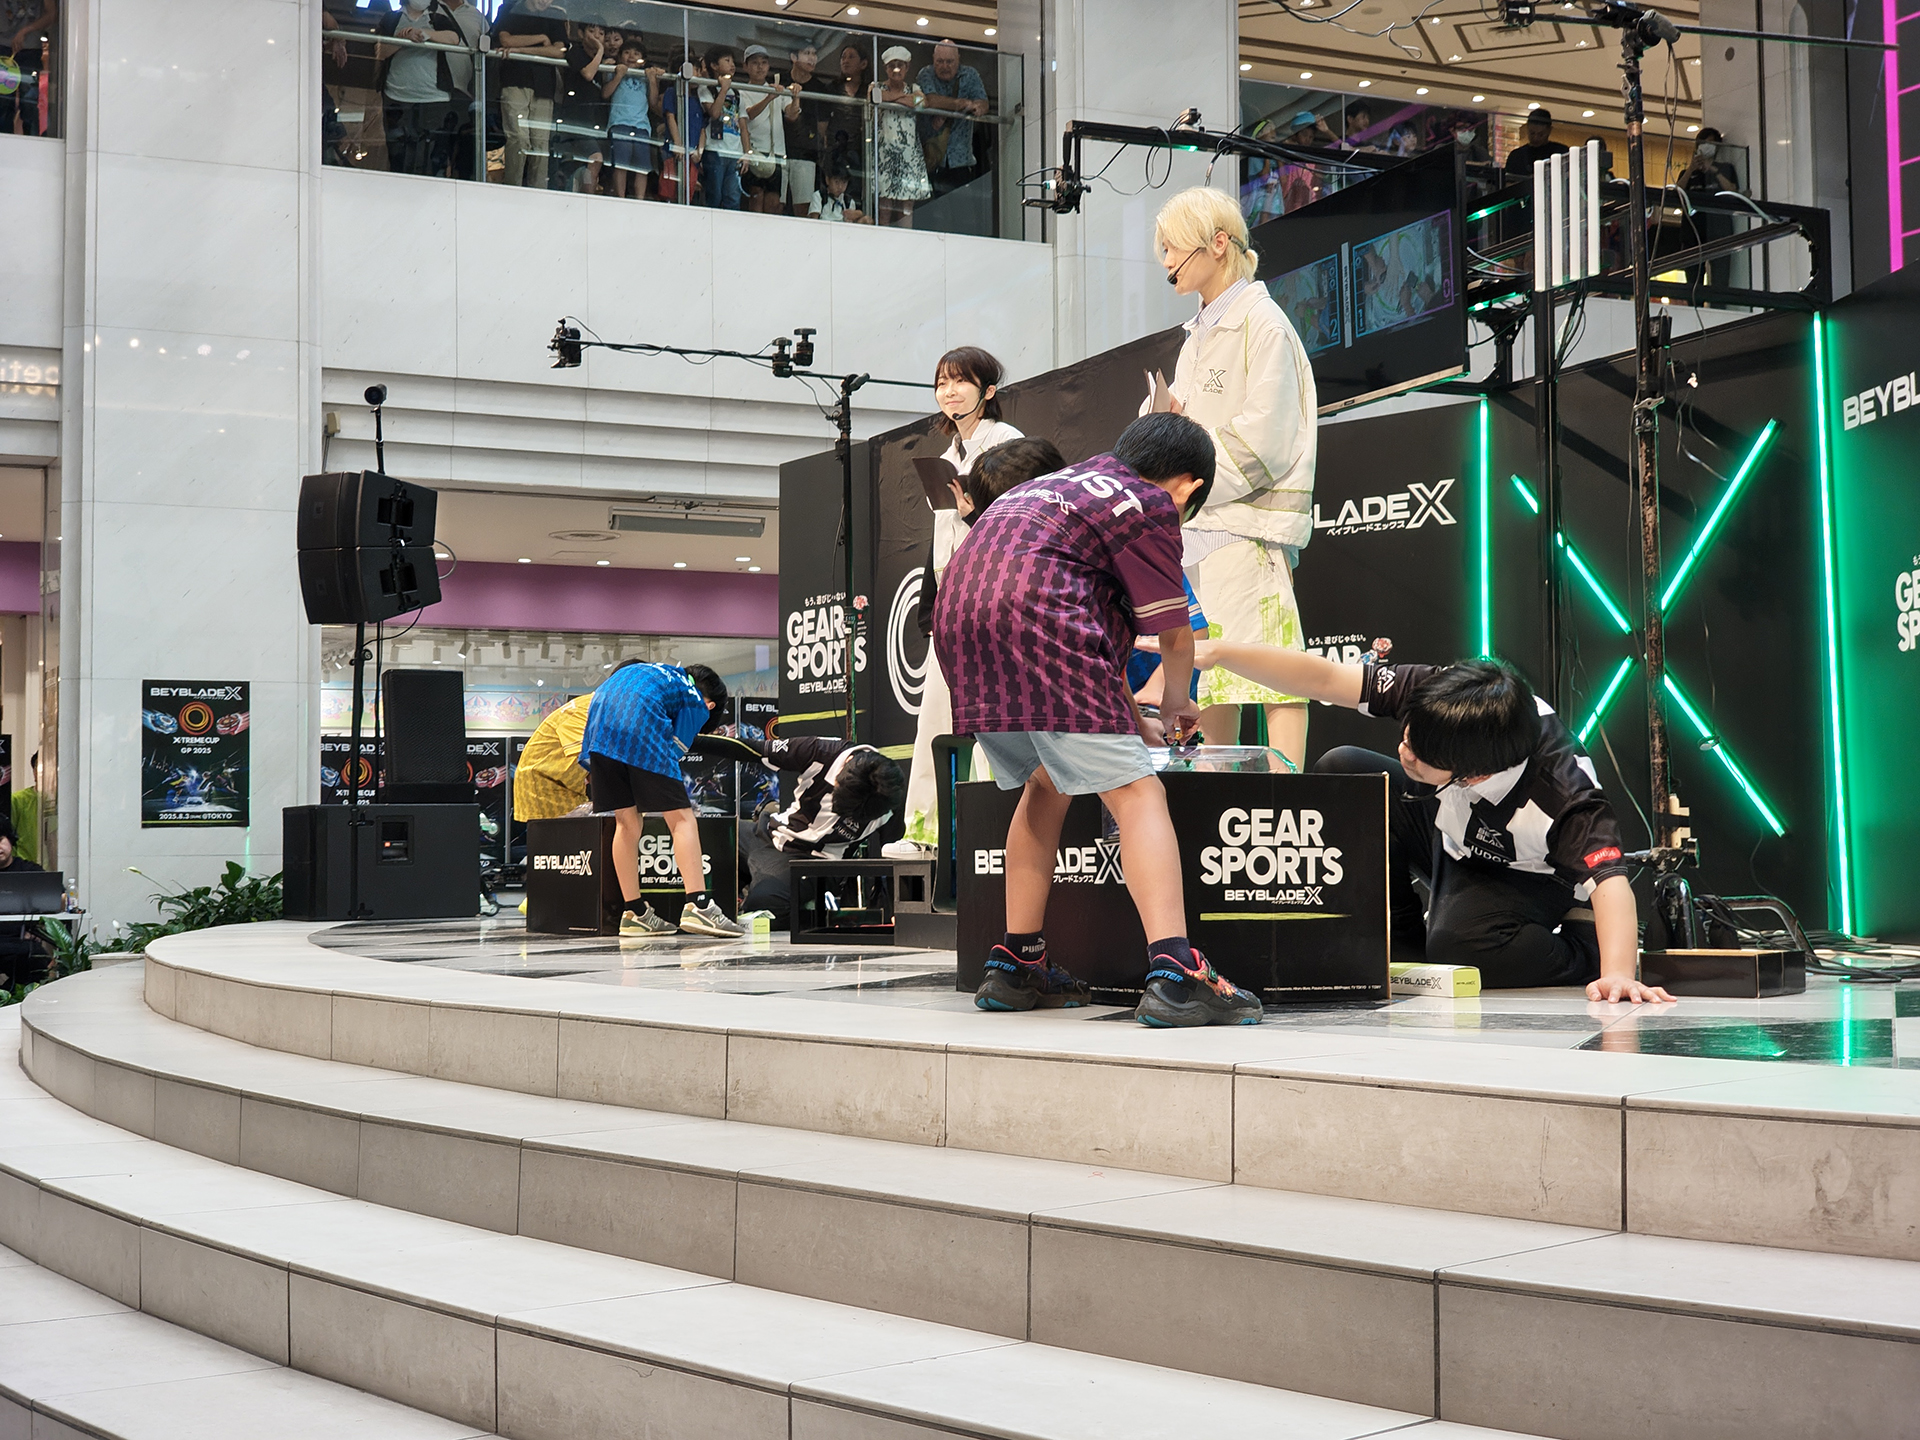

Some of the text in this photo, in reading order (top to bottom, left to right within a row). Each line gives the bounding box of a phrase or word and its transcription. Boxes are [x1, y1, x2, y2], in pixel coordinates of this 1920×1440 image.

[787, 605, 845, 646] GEAR
[1218, 807, 1325, 847] GEAR
[533, 850, 593, 876] BEYBLADEX
[1199, 846, 1344, 885] SPORTS
[1224, 886, 1323, 905] BEYBLADEX
